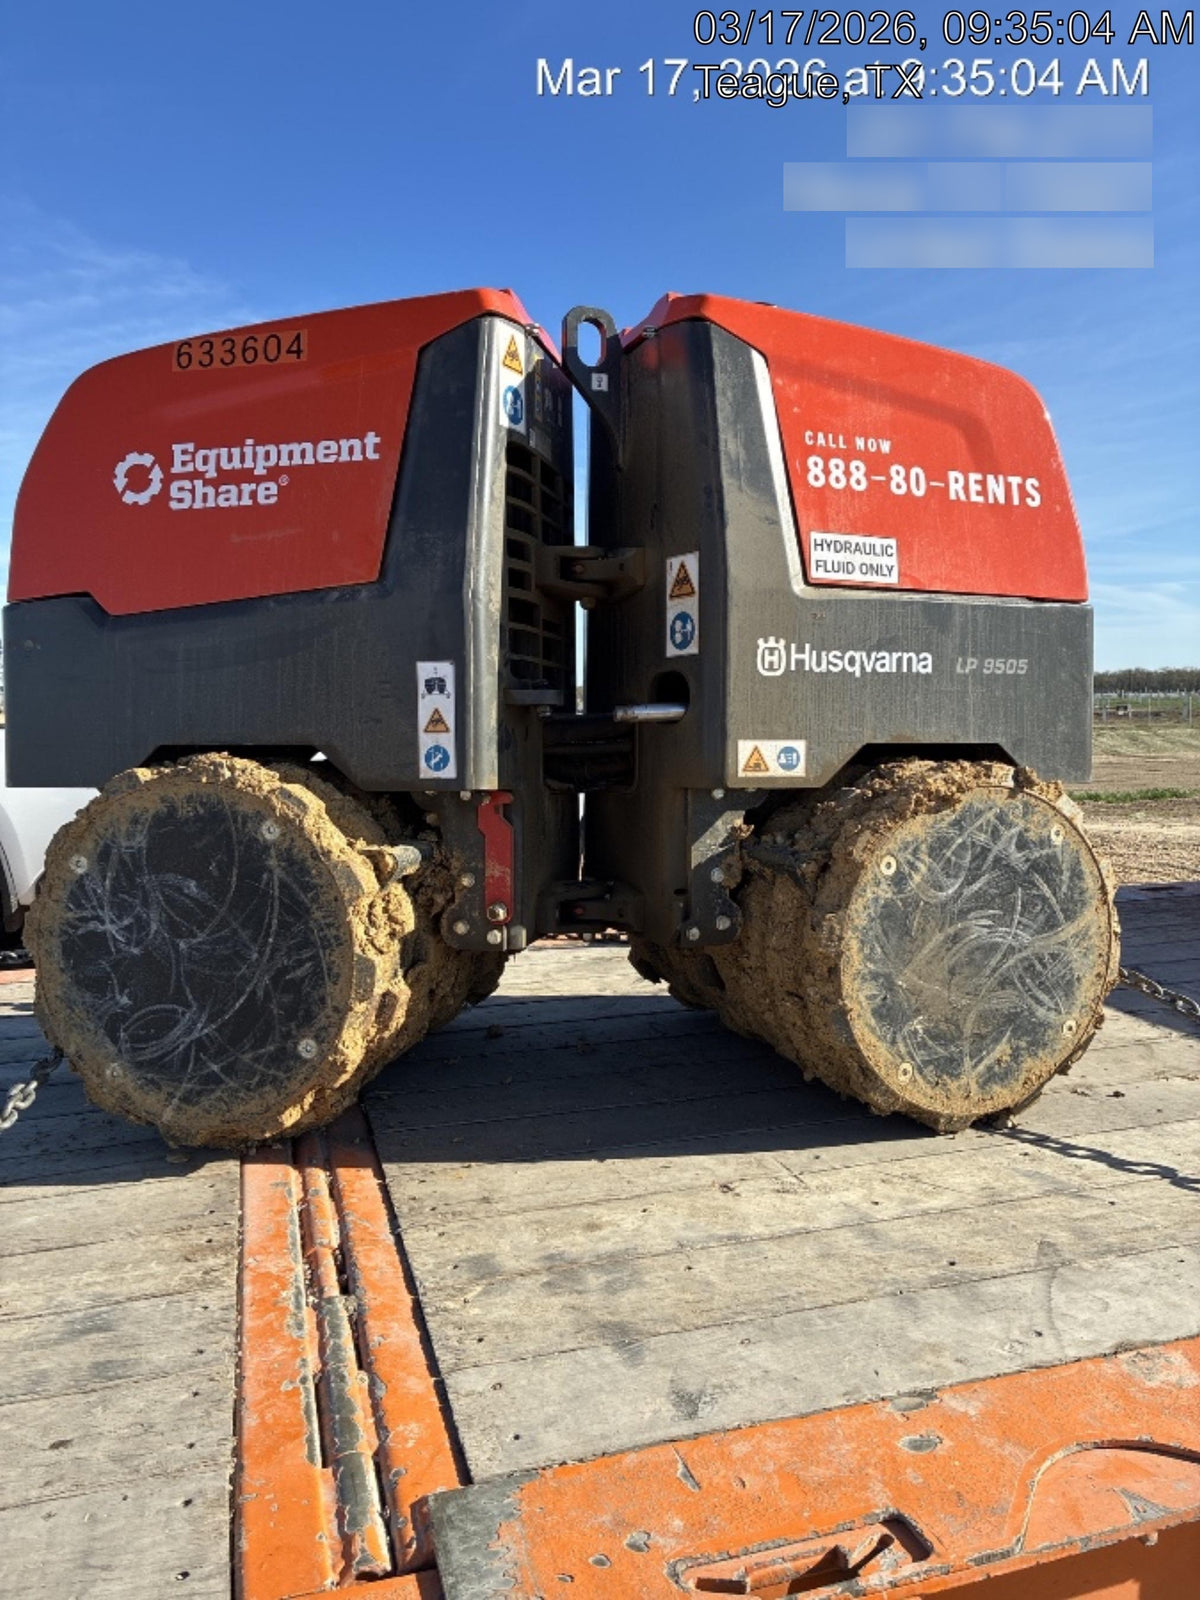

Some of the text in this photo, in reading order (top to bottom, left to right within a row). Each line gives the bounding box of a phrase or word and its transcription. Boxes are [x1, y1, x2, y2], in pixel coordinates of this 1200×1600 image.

[175, 331, 305, 370] 633604
[169, 431, 382, 480] Equipment
[804, 430, 892, 454] CALL NOW
[806, 454, 1042, 508] 888-80-RENTS
[813, 537, 895, 558] HYDRAULIC
[814, 559, 895, 578] FLUID ONLY
[789, 643, 933, 678] Husqvarna
[955, 656, 1029, 675] LP 9505
